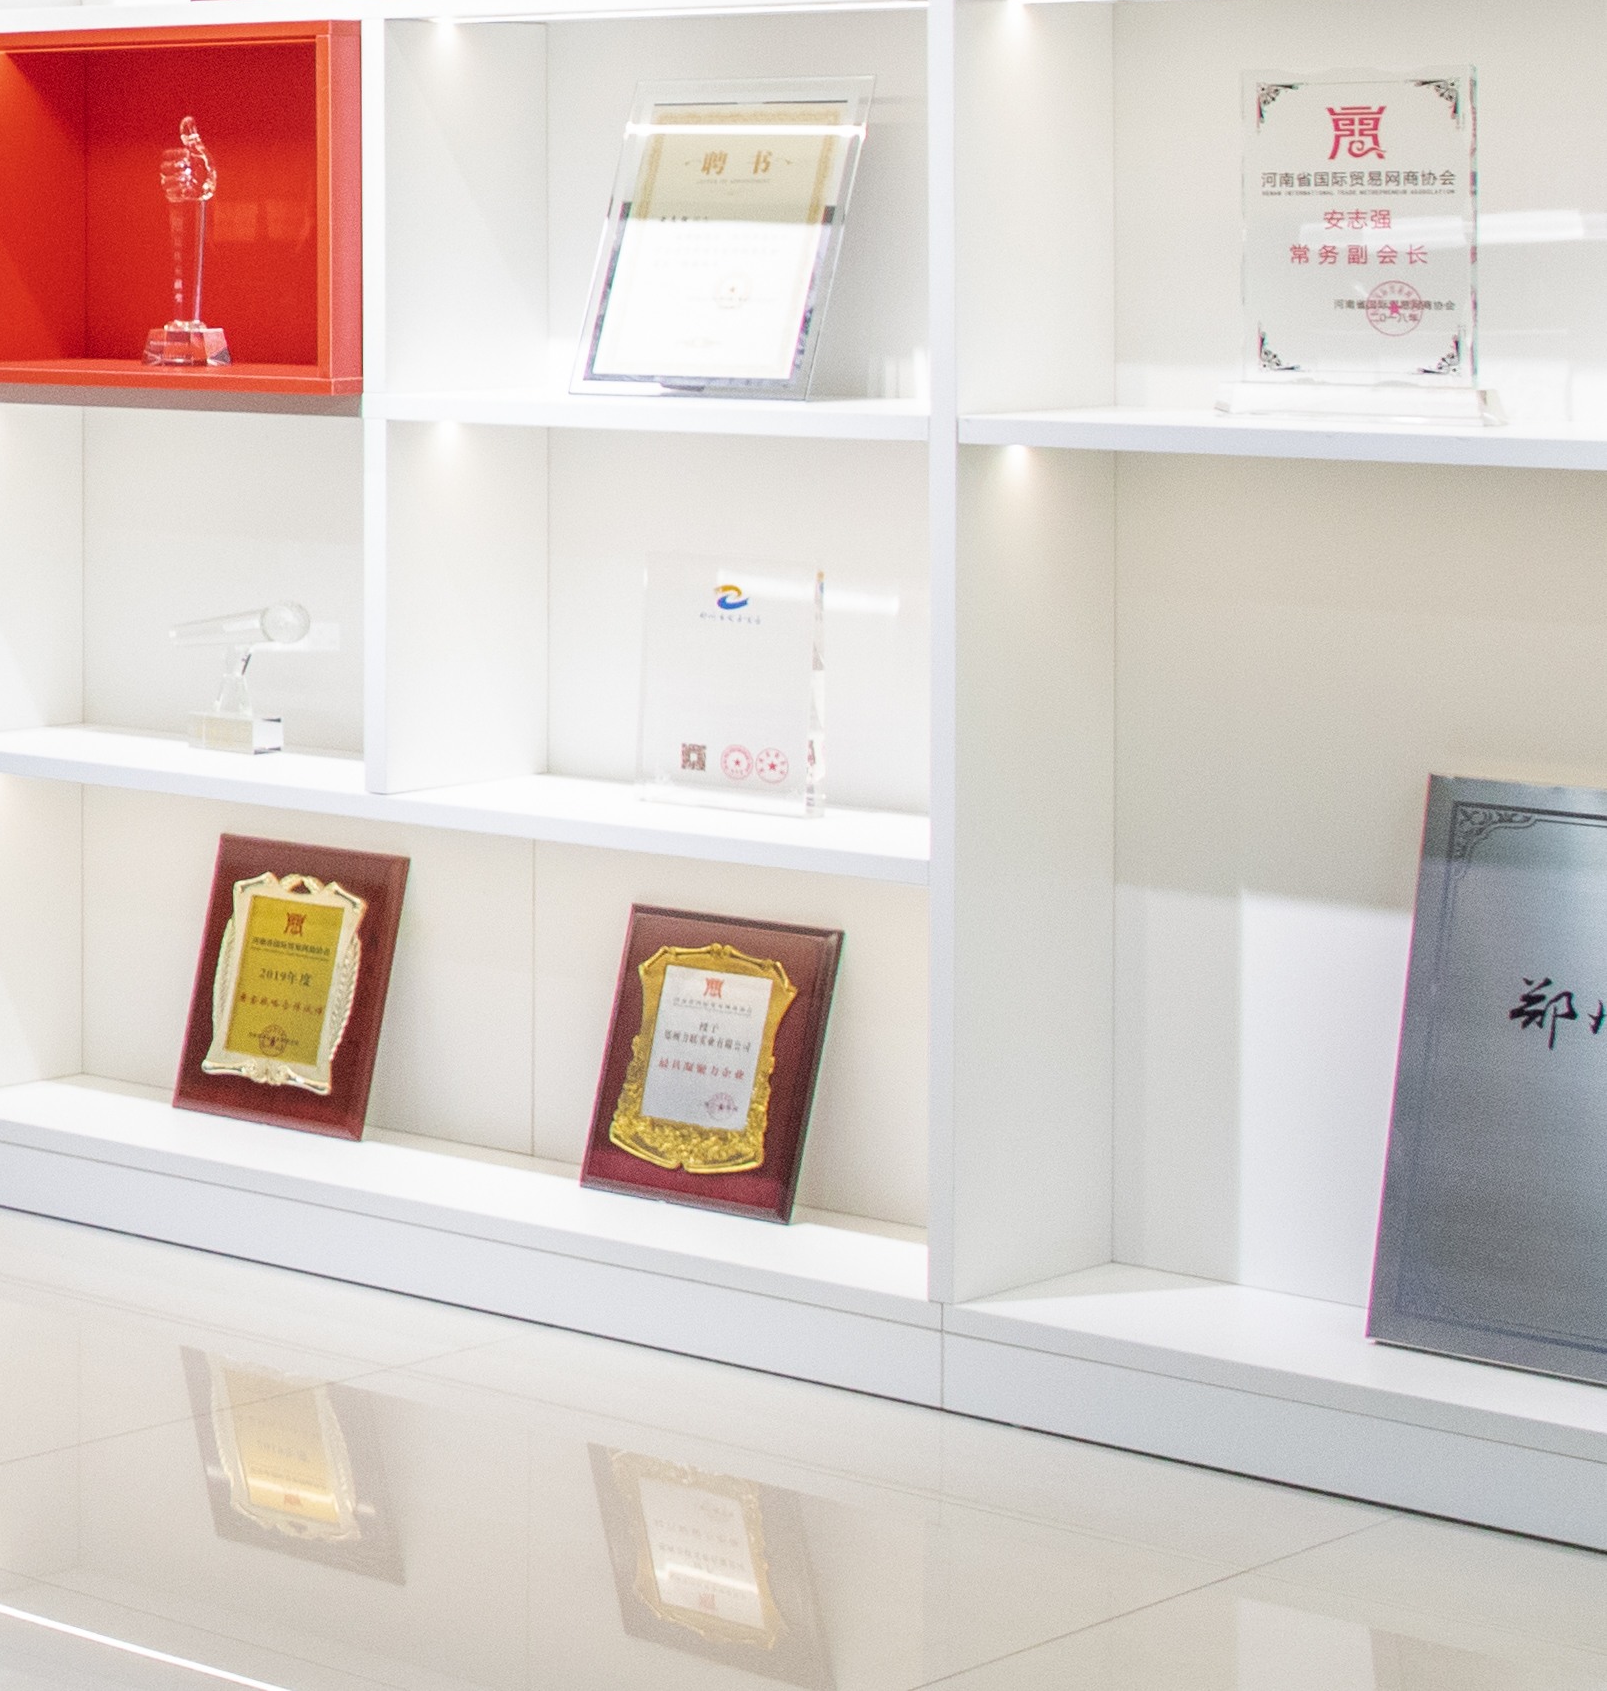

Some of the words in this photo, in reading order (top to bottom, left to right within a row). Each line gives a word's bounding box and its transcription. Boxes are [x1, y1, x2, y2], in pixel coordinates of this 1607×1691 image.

[1261, 169, 1457, 189] 河南省国际贸易网商协会
[1323, 209, 1393, 231] 安志强
[1289, 244, 1428, 265] 常务副会长
[259, 968, 312, 987] 2019年度
